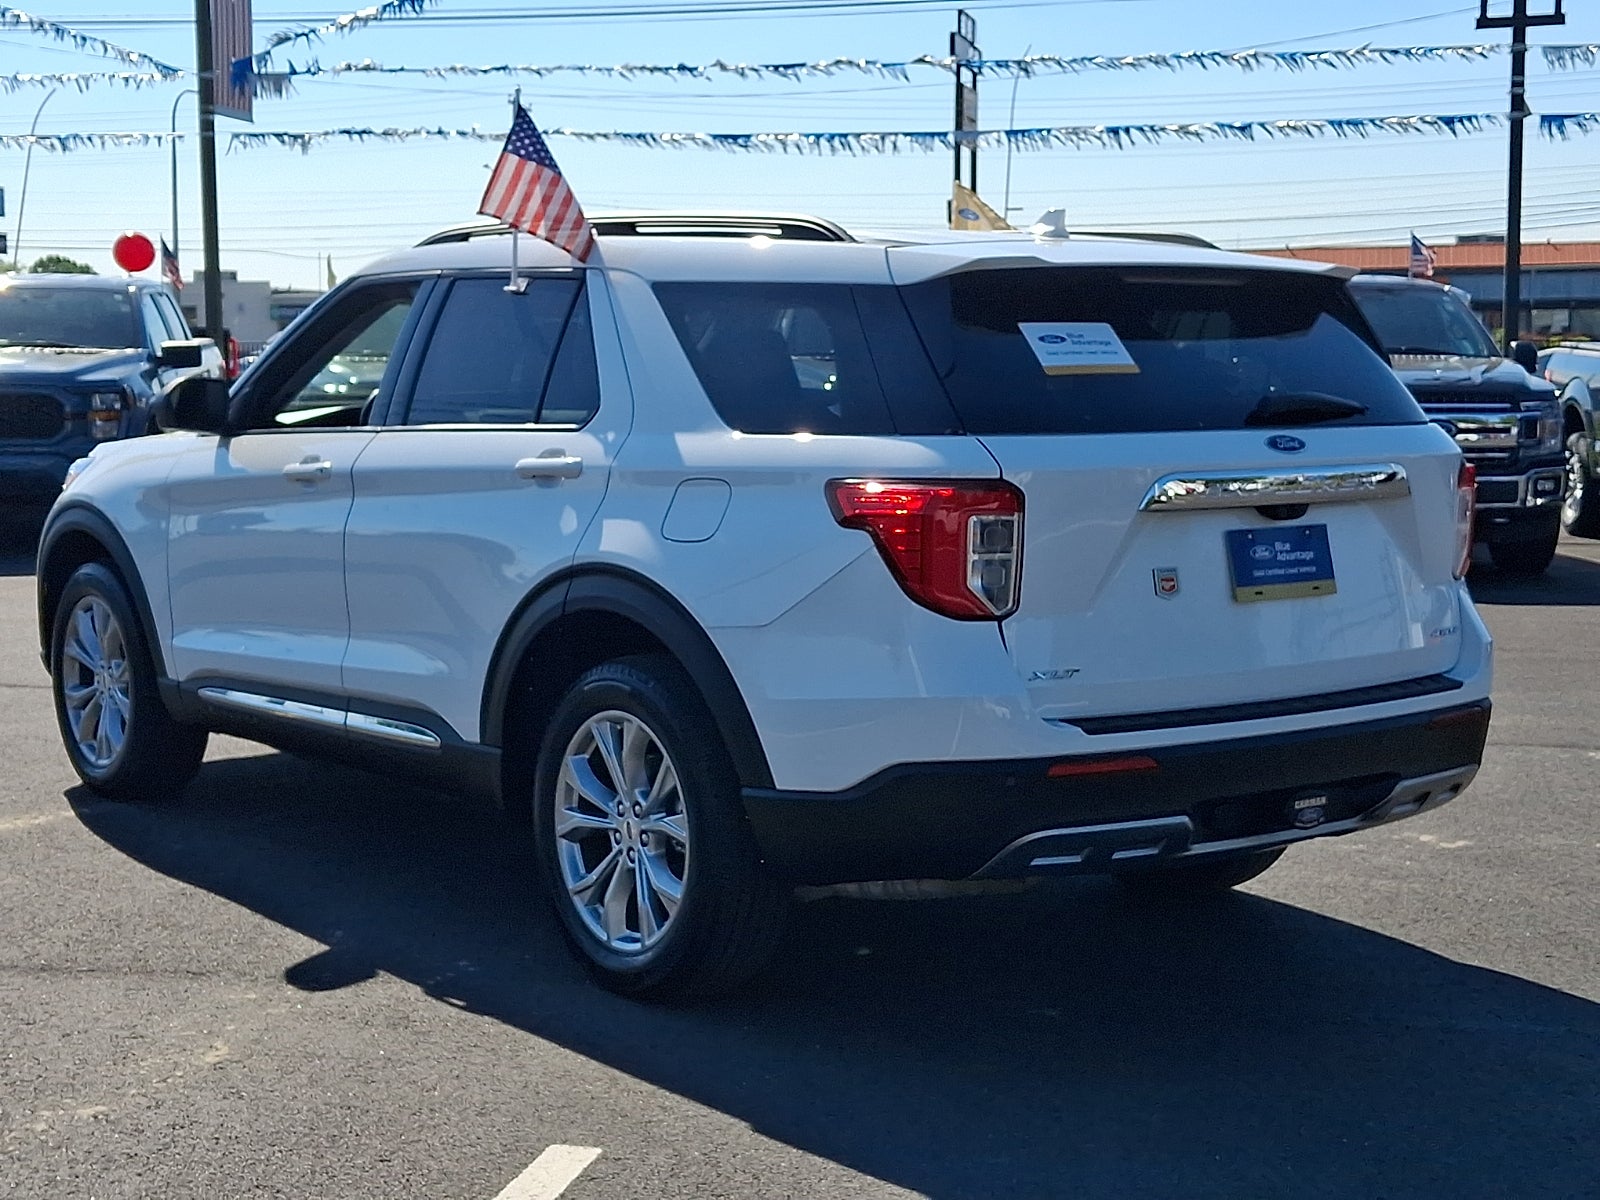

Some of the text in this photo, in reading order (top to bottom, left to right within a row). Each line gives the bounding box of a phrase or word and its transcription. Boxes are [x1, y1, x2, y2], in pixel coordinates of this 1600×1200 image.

[1275, 542, 1291, 552] Blue
[1277, 551, 1314, 560] Advantage
[1028, 668, 1081, 682] XLT
